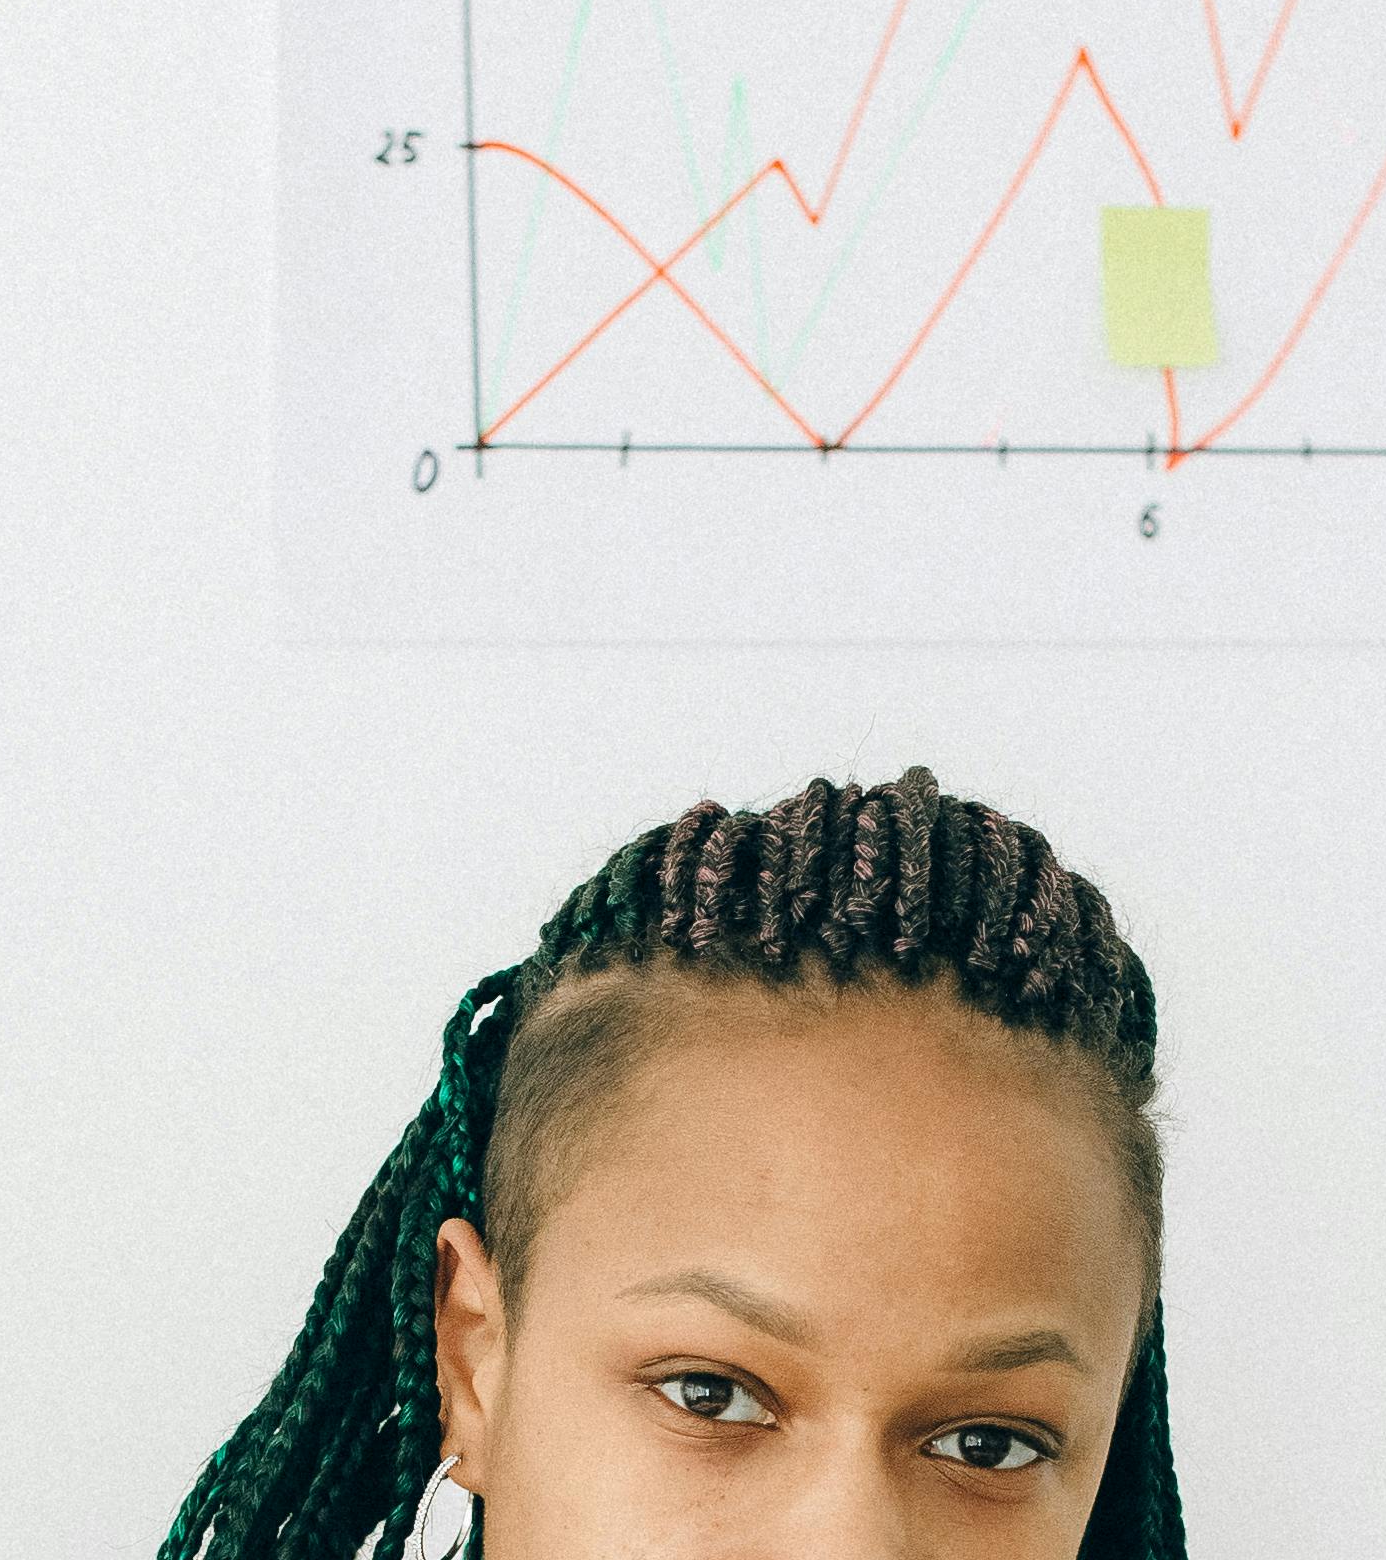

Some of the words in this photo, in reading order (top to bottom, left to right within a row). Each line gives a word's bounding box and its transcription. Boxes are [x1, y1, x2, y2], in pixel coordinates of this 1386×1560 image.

[375, 131, 423, 164] 25
[414, 449, 438, 493] 0
[1139, 503, 1160, 539] 6
